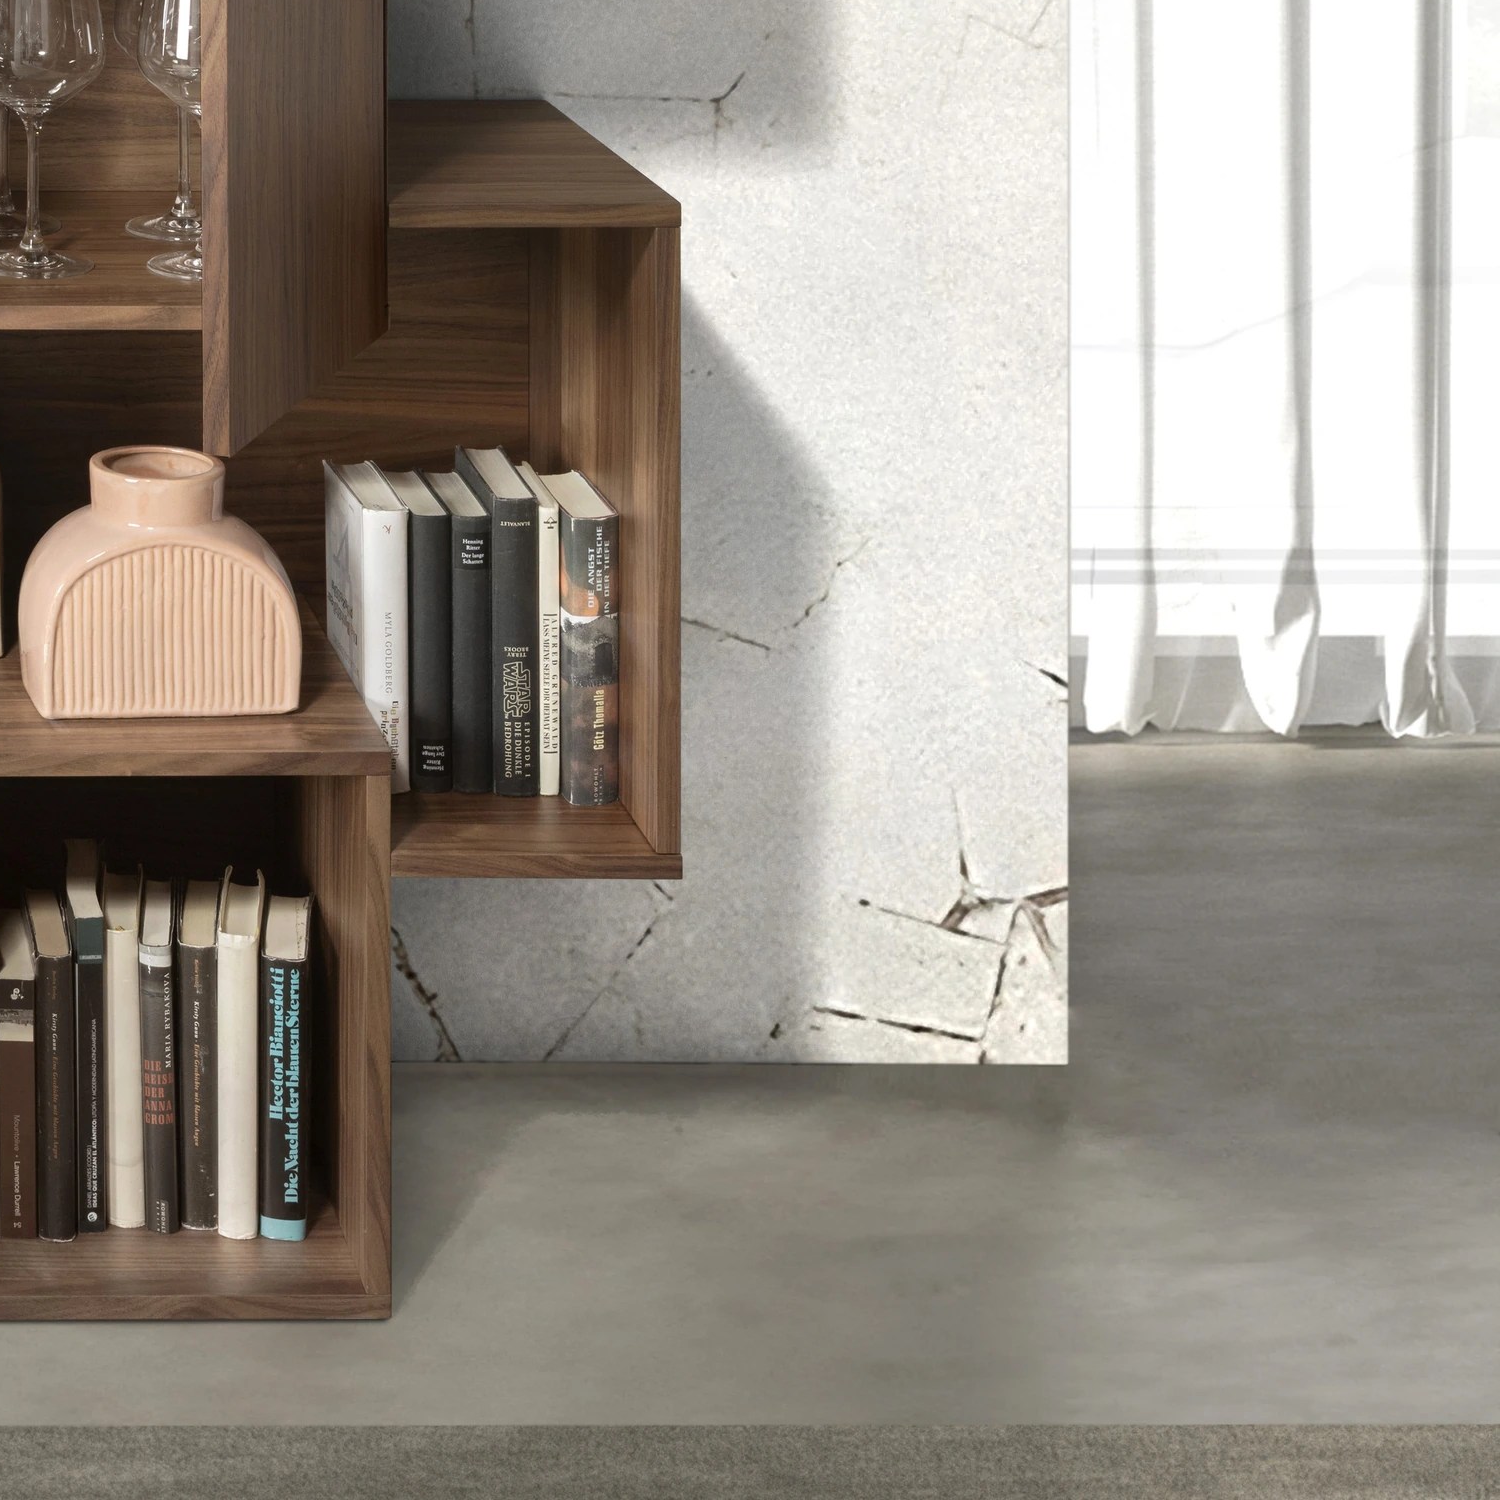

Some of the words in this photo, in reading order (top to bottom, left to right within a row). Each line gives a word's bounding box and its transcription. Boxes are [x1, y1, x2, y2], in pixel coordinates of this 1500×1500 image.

[385, 611, 393, 638] MYLA
[604, 601, 610, 613] IN
[385, 641, 393, 694] GOLDBERG
[502, 663, 520, 717] WARS
[593, 689, 605, 729] Thomalla
[504, 721, 513, 778] BEDROHUNG
[514, 738, 522, 774] DUNKLE
[593, 731, 605, 750] Götz
[163, 972, 171, 1029] RYBAKOVA
[269, 966, 284, 1057] Bianciotti
[284, 968, 299, 1027] Sterne
[144, 1060, 161, 1071] DIE
[284, 1027, 299, 1086] blauen
[144, 1073, 174, 1085] REISE
[145, 1087, 165, 1098] DER
[269, 1057, 283, 1120] Hector
[145, 1099, 173, 1111] ANNA
[145, 1113, 174, 1125] GROM
[284, 1087, 299, 1119] der
[13, 1114, 21, 1152] Mountolive
[284, 1120, 299, 1171] Nacht
[13, 1161, 21, 1194] Lawrence
[284, 1173, 299, 1203] Die
